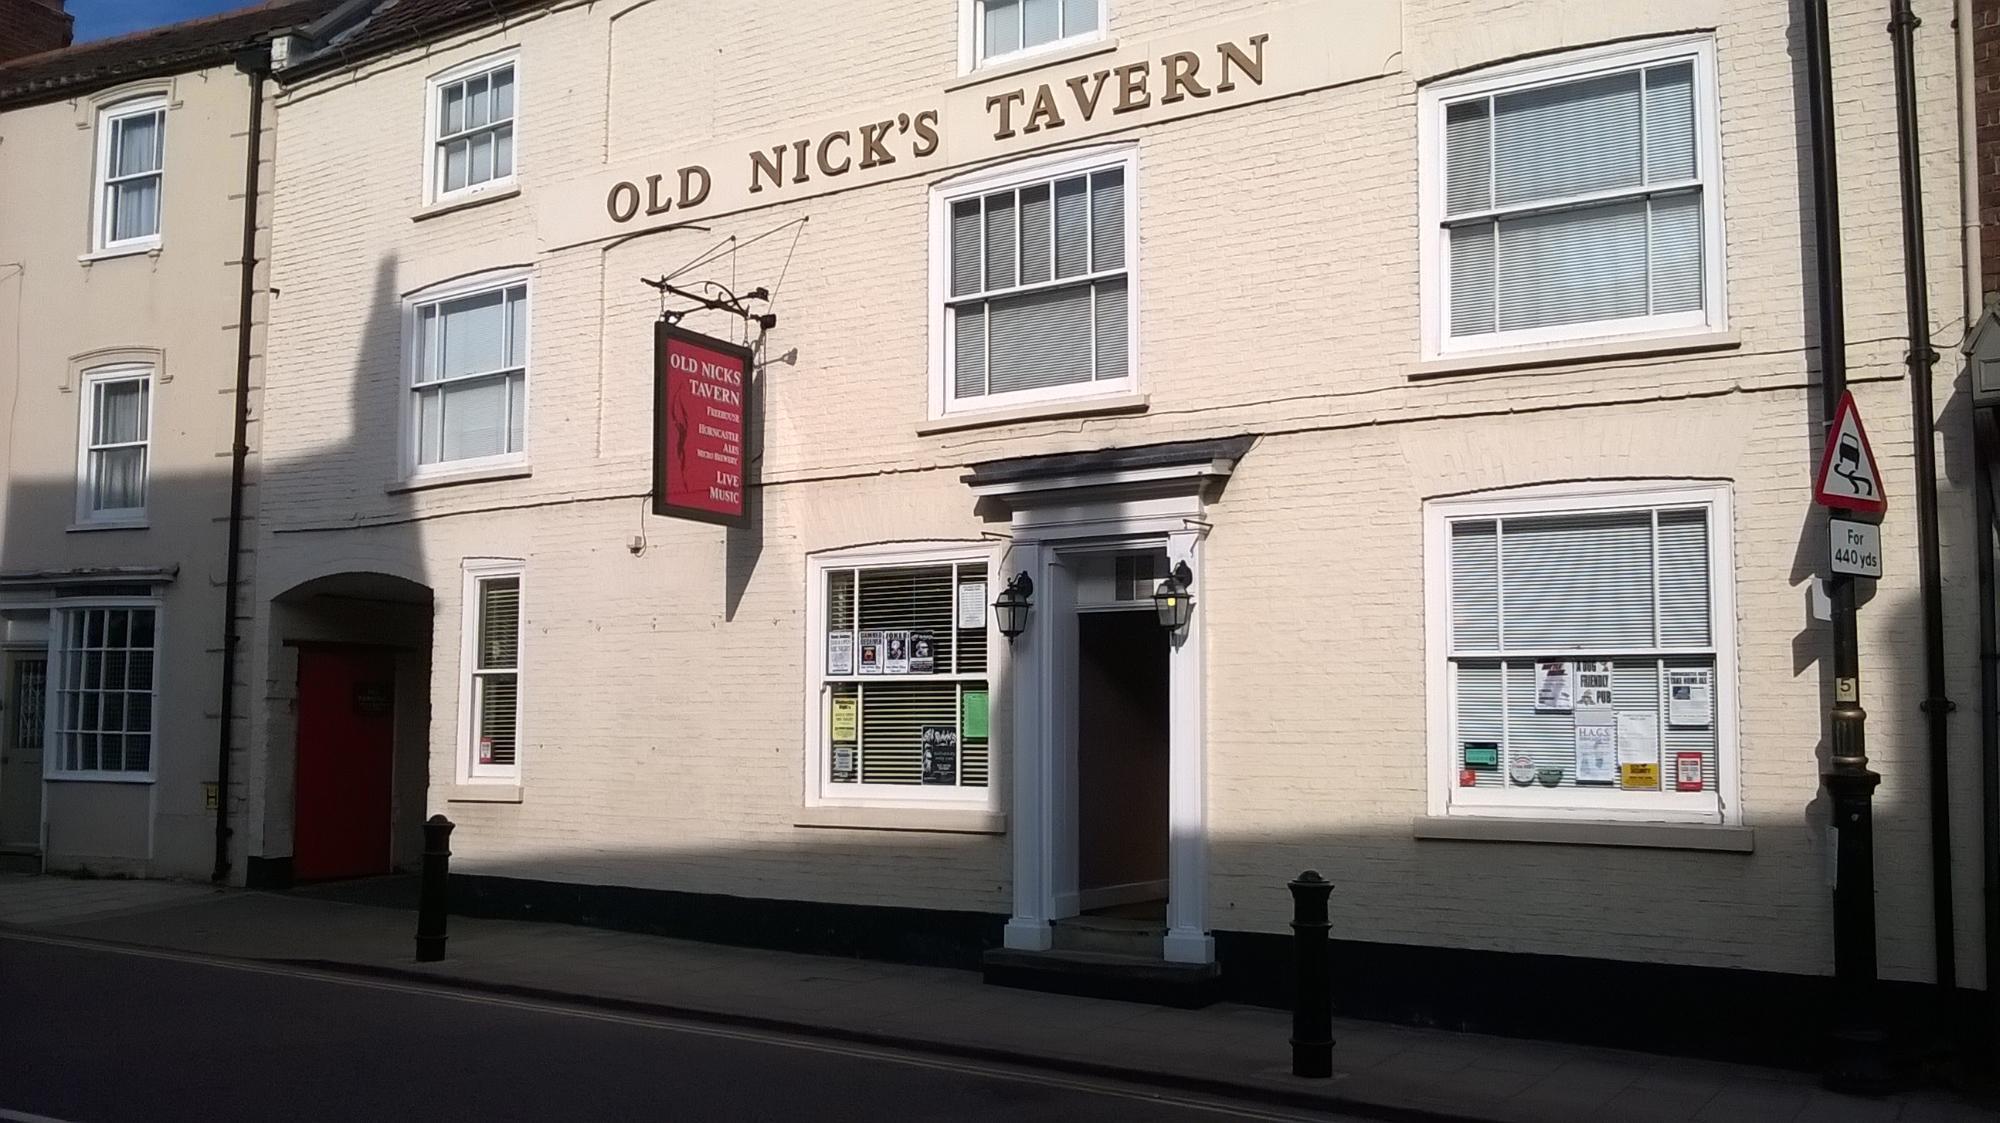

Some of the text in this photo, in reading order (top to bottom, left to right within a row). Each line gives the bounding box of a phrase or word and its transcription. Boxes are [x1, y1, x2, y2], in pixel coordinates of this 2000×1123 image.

[607, 34, 1268, 223] OLD NICK'S TAVERN
[670, 353, 741, 385] OLD NICKS
[689, 379, 740, 405] TAVERN
[699, 423, 739, 442] HORNCASTLE
[717, 470, 740, 487] LIVE
[709, 486, 740, 504] MUSIC
[1847, 529, 1864, 545] For
[1835, 548, 1877, 569] 440 yds
[1581, 675, 1609, 688] FRIENDLY
[1840, 678, 1851, 692] 5
[1597, 690, 1612, 704] PUB
